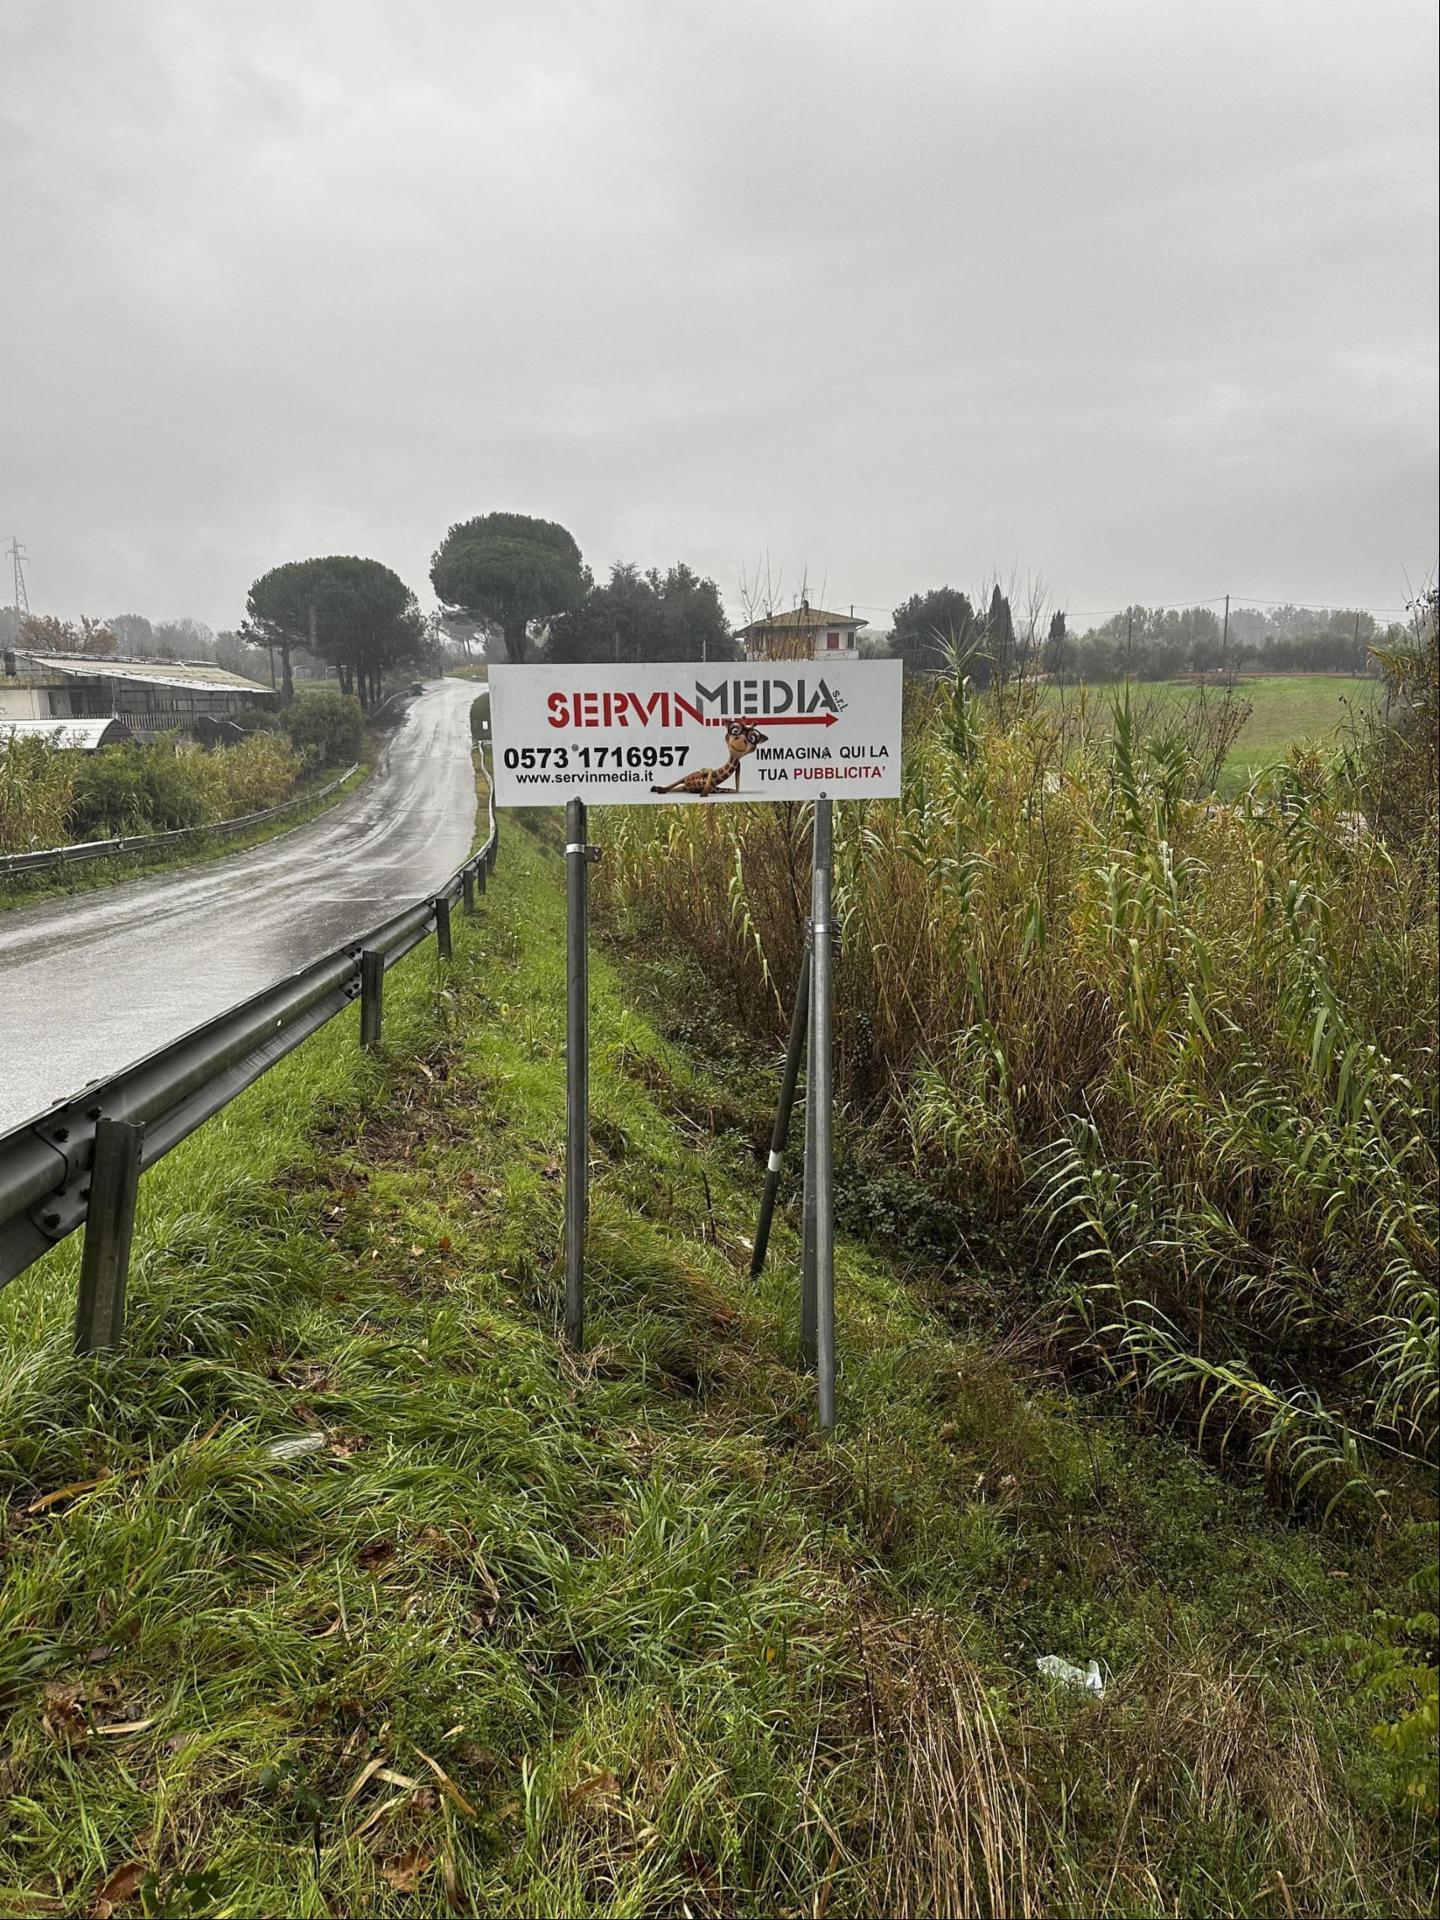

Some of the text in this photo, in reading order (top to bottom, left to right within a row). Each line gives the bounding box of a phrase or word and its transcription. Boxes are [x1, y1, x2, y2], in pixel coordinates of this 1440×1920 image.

[695, 678, 840, 715] MEDIA
[503, 746, 690, 769] 0573 1716957
[756, 745, 890, 760] IMMAGINA QUI LA
[516, 769, 654, 784] www.servinmedia.it
[758, 766, 887, 781] TUA PUBBLICITA'
